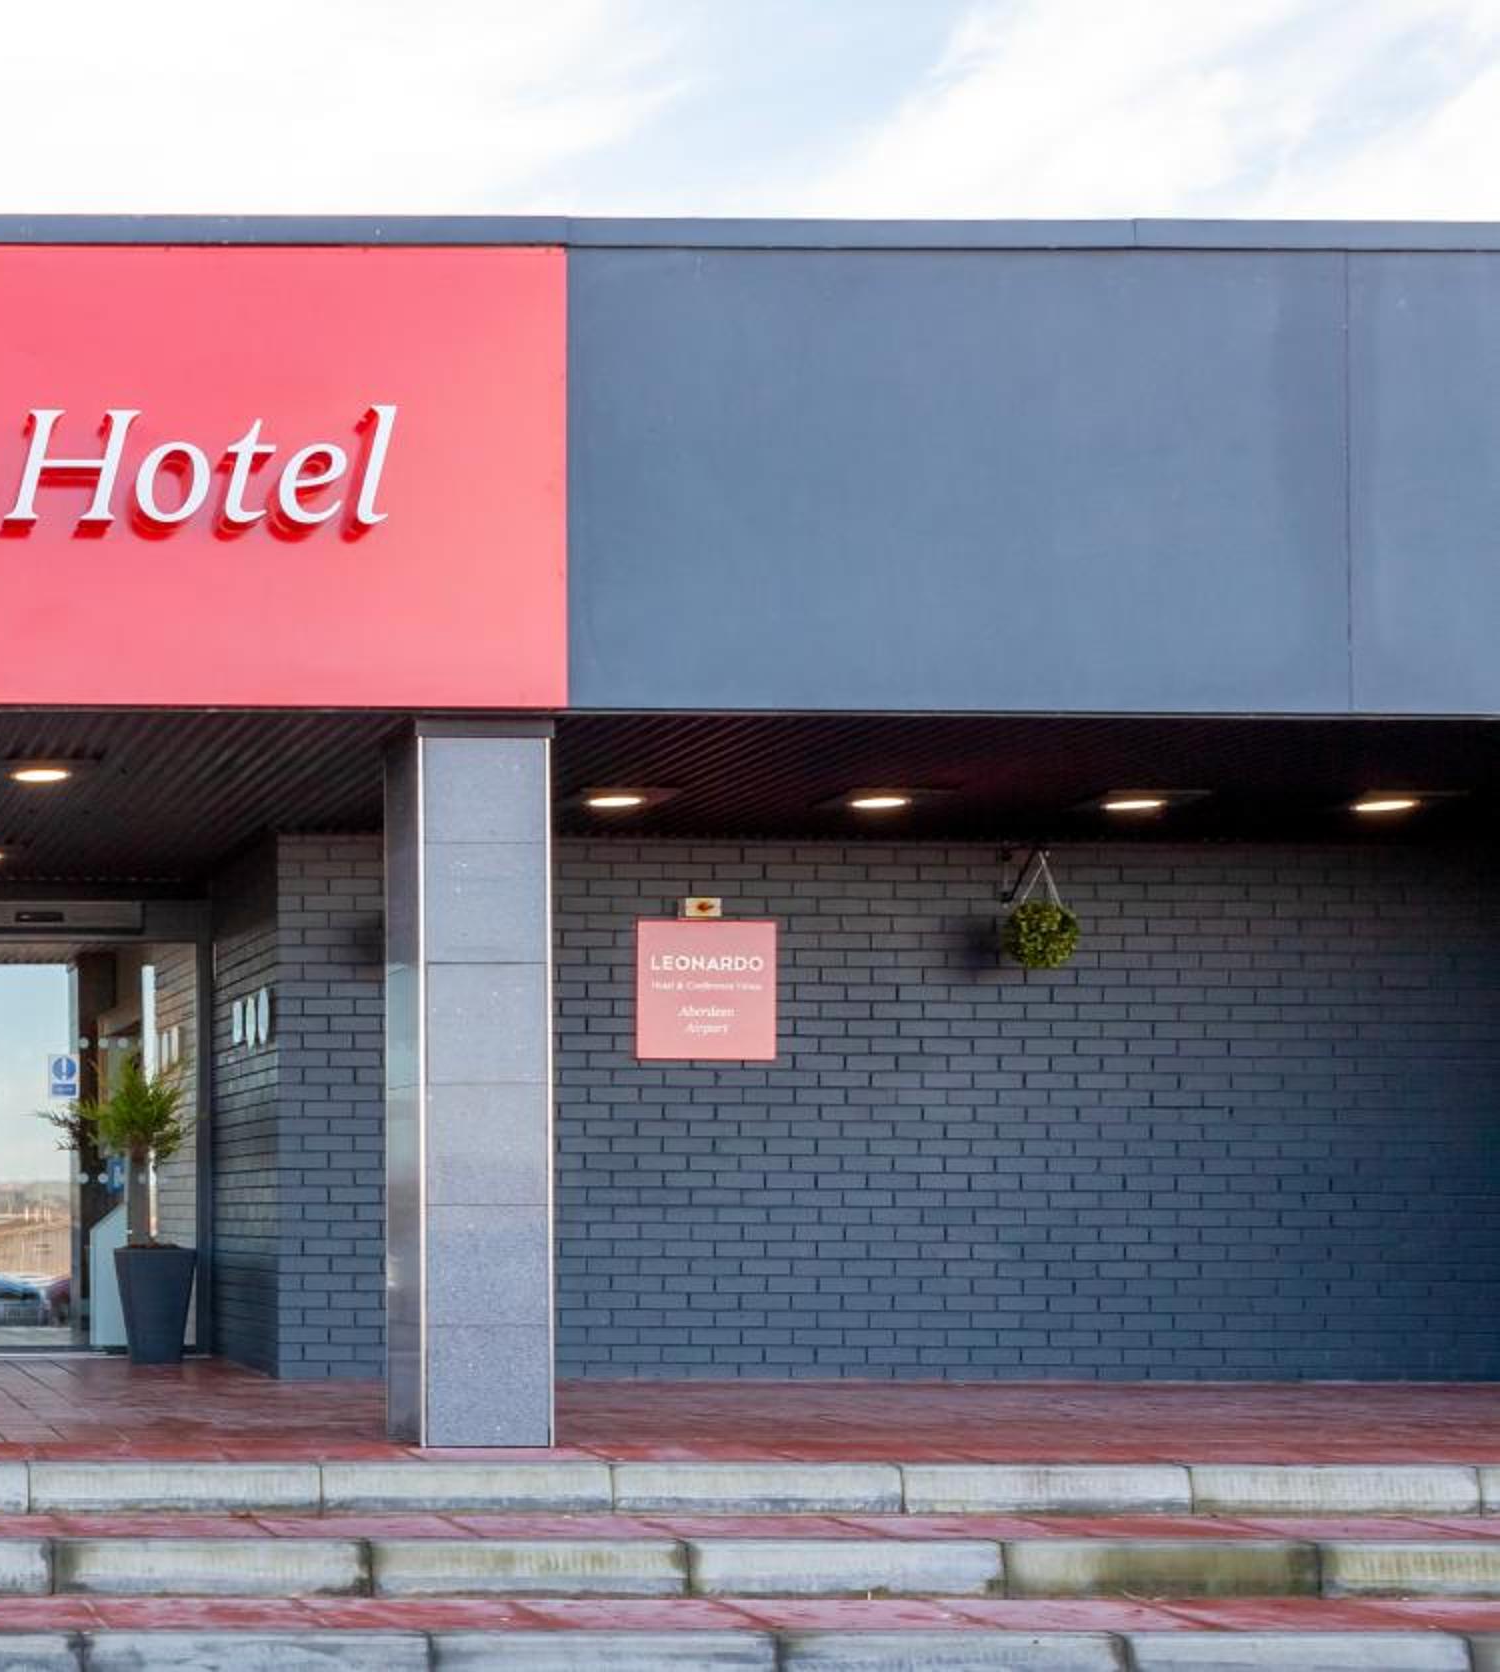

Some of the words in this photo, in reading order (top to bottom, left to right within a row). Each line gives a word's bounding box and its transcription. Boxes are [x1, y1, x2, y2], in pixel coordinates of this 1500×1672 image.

[3, 405, 398, 525] Hotel
[651, 955, 764, 971] LEONARDO
[677, 1004, 736, 1017] Aberdeen
[685, 1022, 729, 1036] Airport
